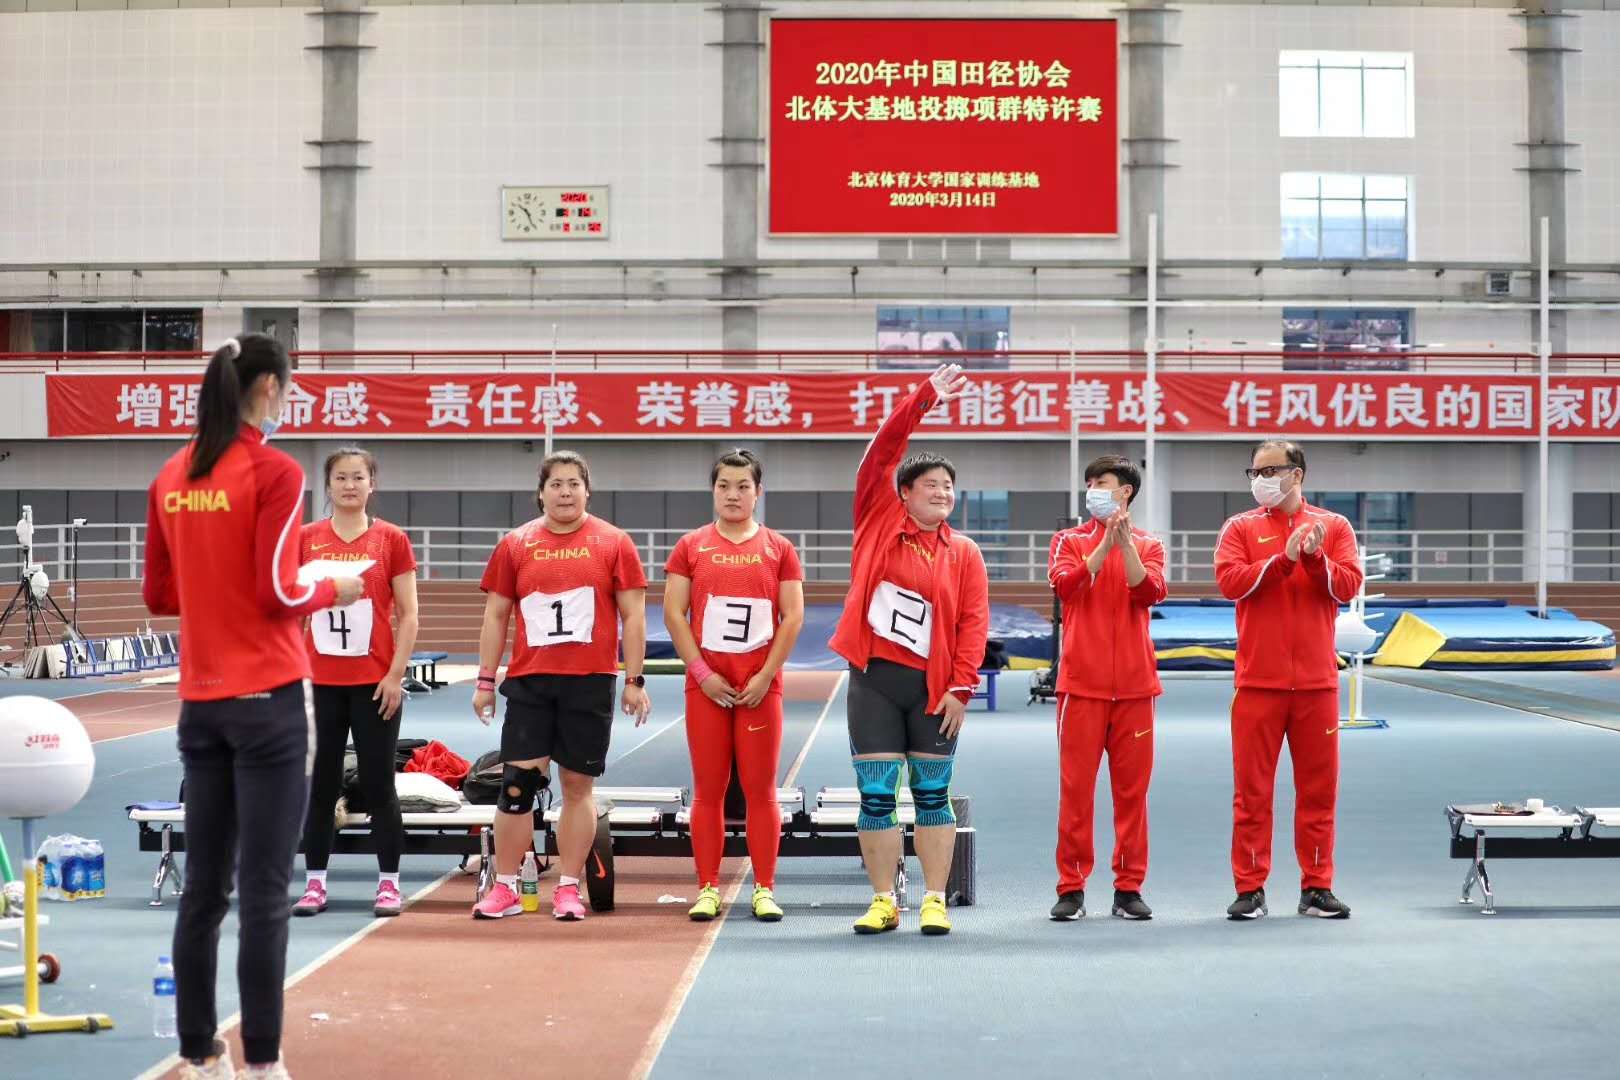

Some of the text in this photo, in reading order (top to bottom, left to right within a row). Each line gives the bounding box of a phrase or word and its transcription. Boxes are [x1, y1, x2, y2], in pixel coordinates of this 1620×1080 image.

[815, 60, 1072, 88] 2020年中国田径协会
[785, 95, 1103, 123] 北体大基地投掷项群特许赛
[848, 171, 1040, 189] 北京体育大学国家训练基地
[889, 191, 997, 208] 2020年3月14日
[164, 489, 231, 513] CHINA
[533, 546, 591, 561] CHINA
[712, 553, 763, 564] CHINA
[328, 610, 351, 650] 4
[547, 600, 573, 636] 1
[722, 603, 751, 643] 3
[891, 591, 926, 644] 2
